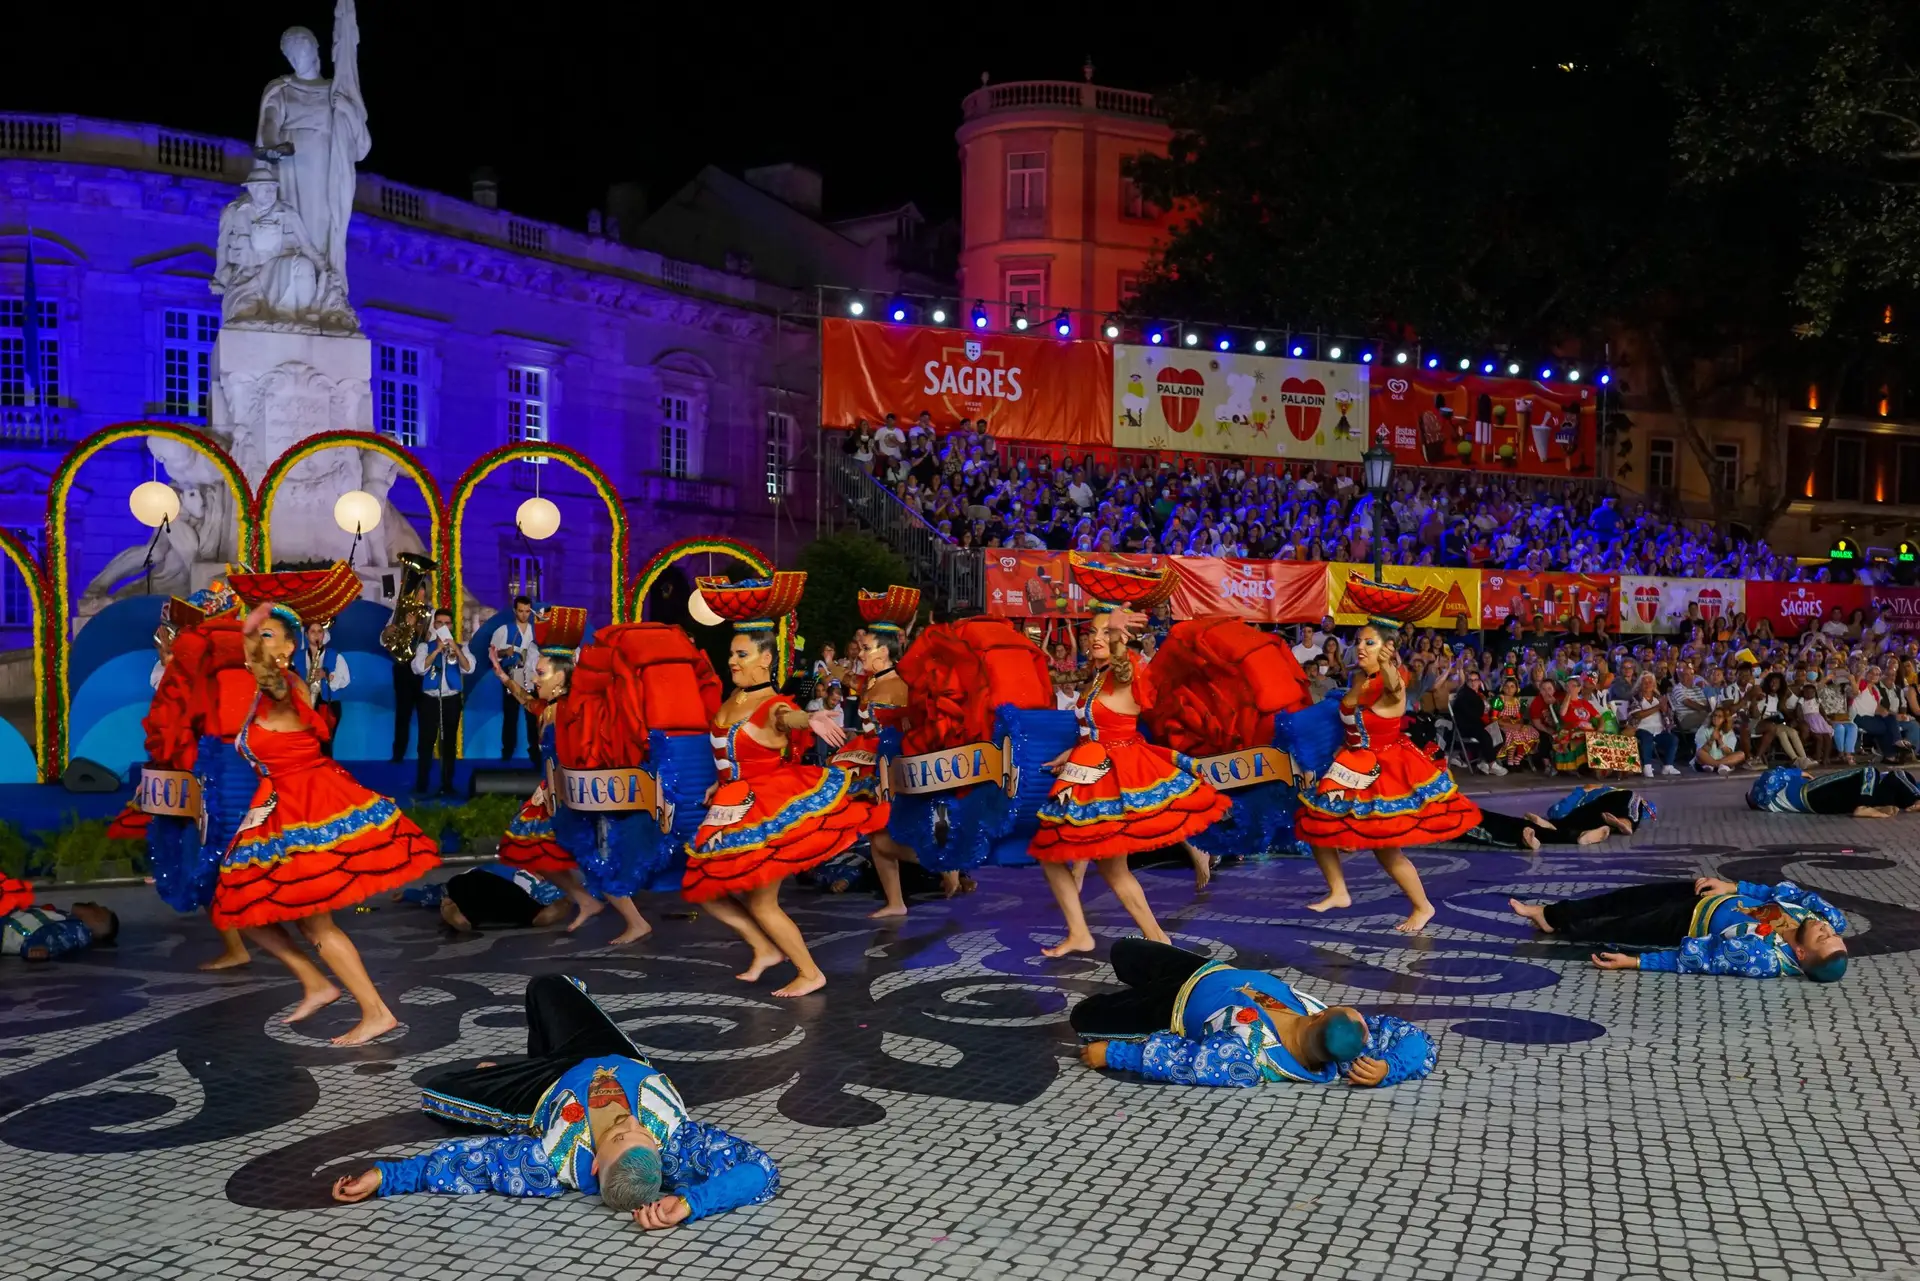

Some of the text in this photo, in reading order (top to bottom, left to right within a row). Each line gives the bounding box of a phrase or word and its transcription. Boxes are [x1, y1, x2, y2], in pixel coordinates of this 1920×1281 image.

[924, 361, 1022, 401] SAGRES
[1157, 384, 1204, 397] PALADIN
[1281, 394, 1325, 406] PALADIN
[1830, 550, 1853, 559] ROLEX
[1220, 576, 1276, 600] SAGRES
[1781, 599, 1822, 617] SAGRES
[567, 775, 645, 804] RAGOA
